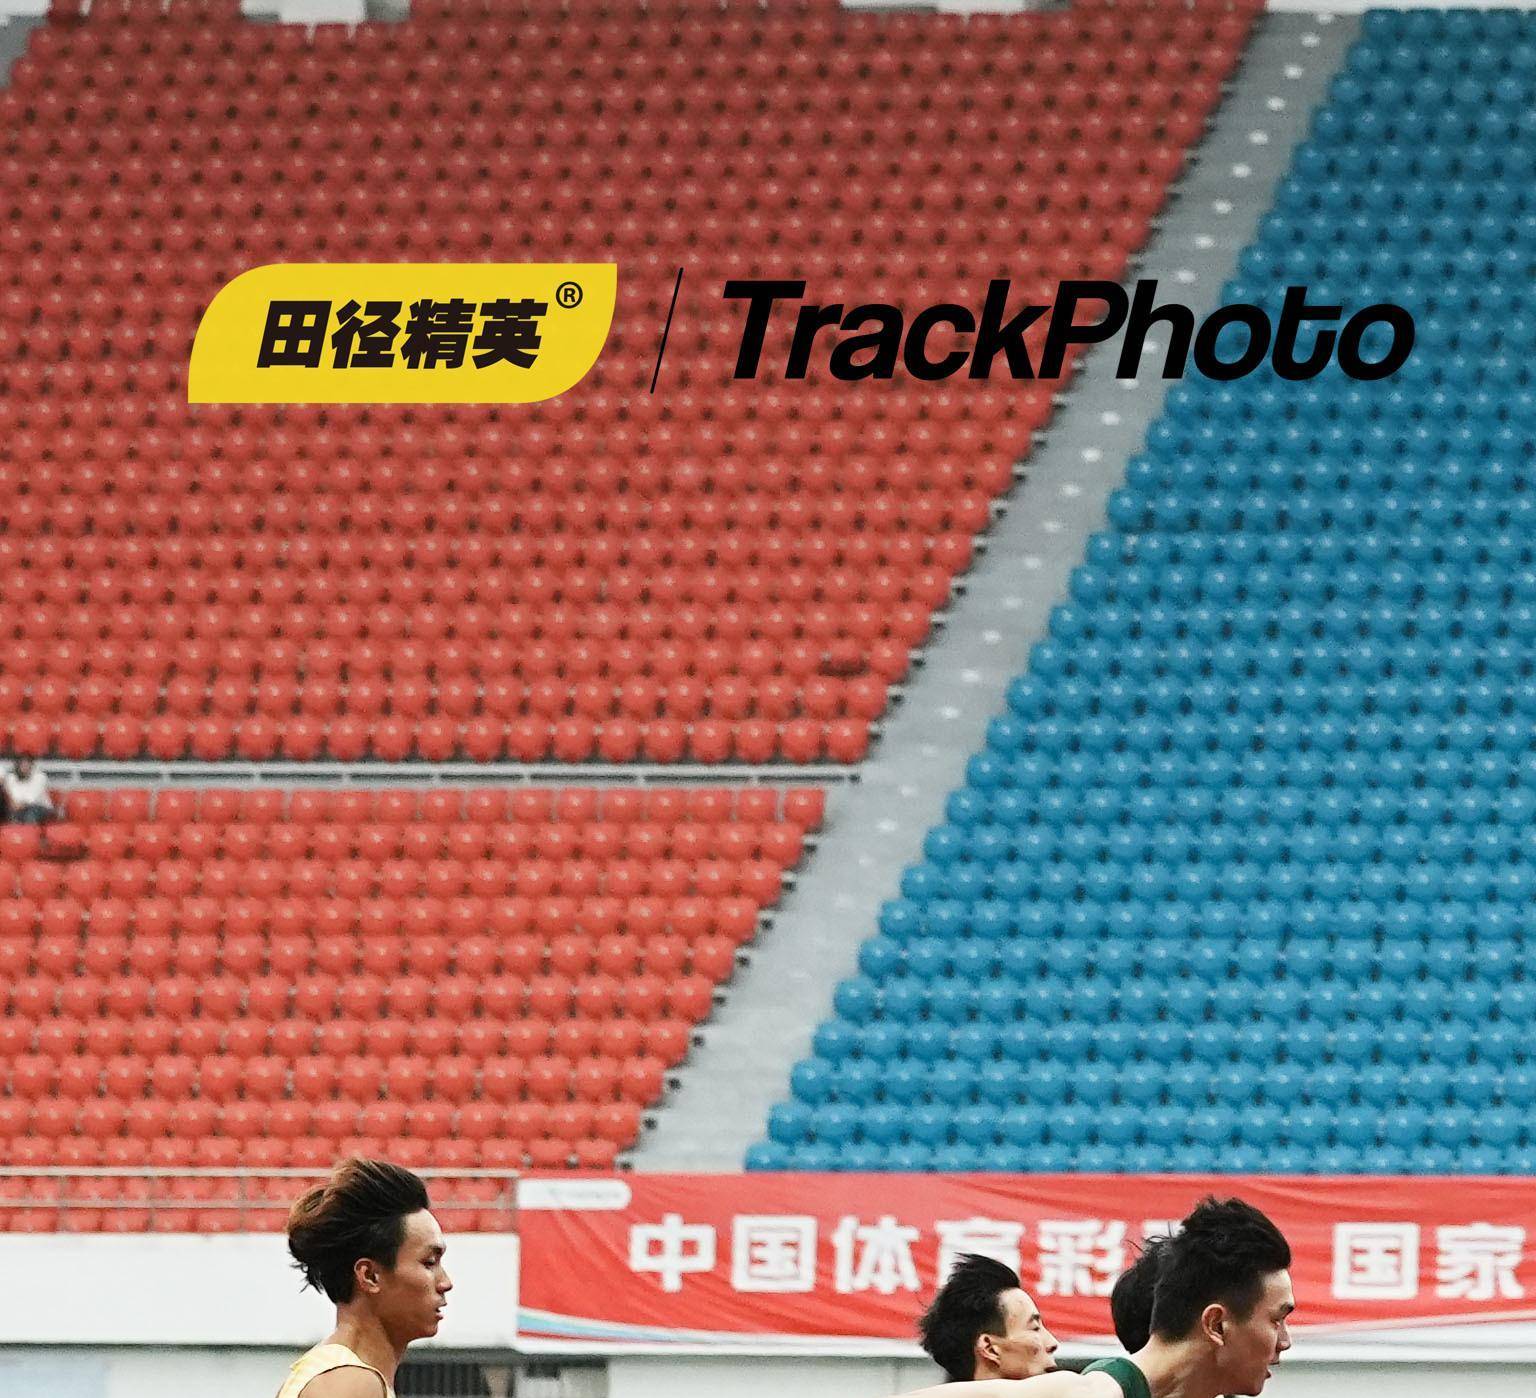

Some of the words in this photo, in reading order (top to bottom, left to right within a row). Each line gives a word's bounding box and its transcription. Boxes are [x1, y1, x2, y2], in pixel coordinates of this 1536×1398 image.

[629, 1212, 1190, 1297] 中国体育彩
